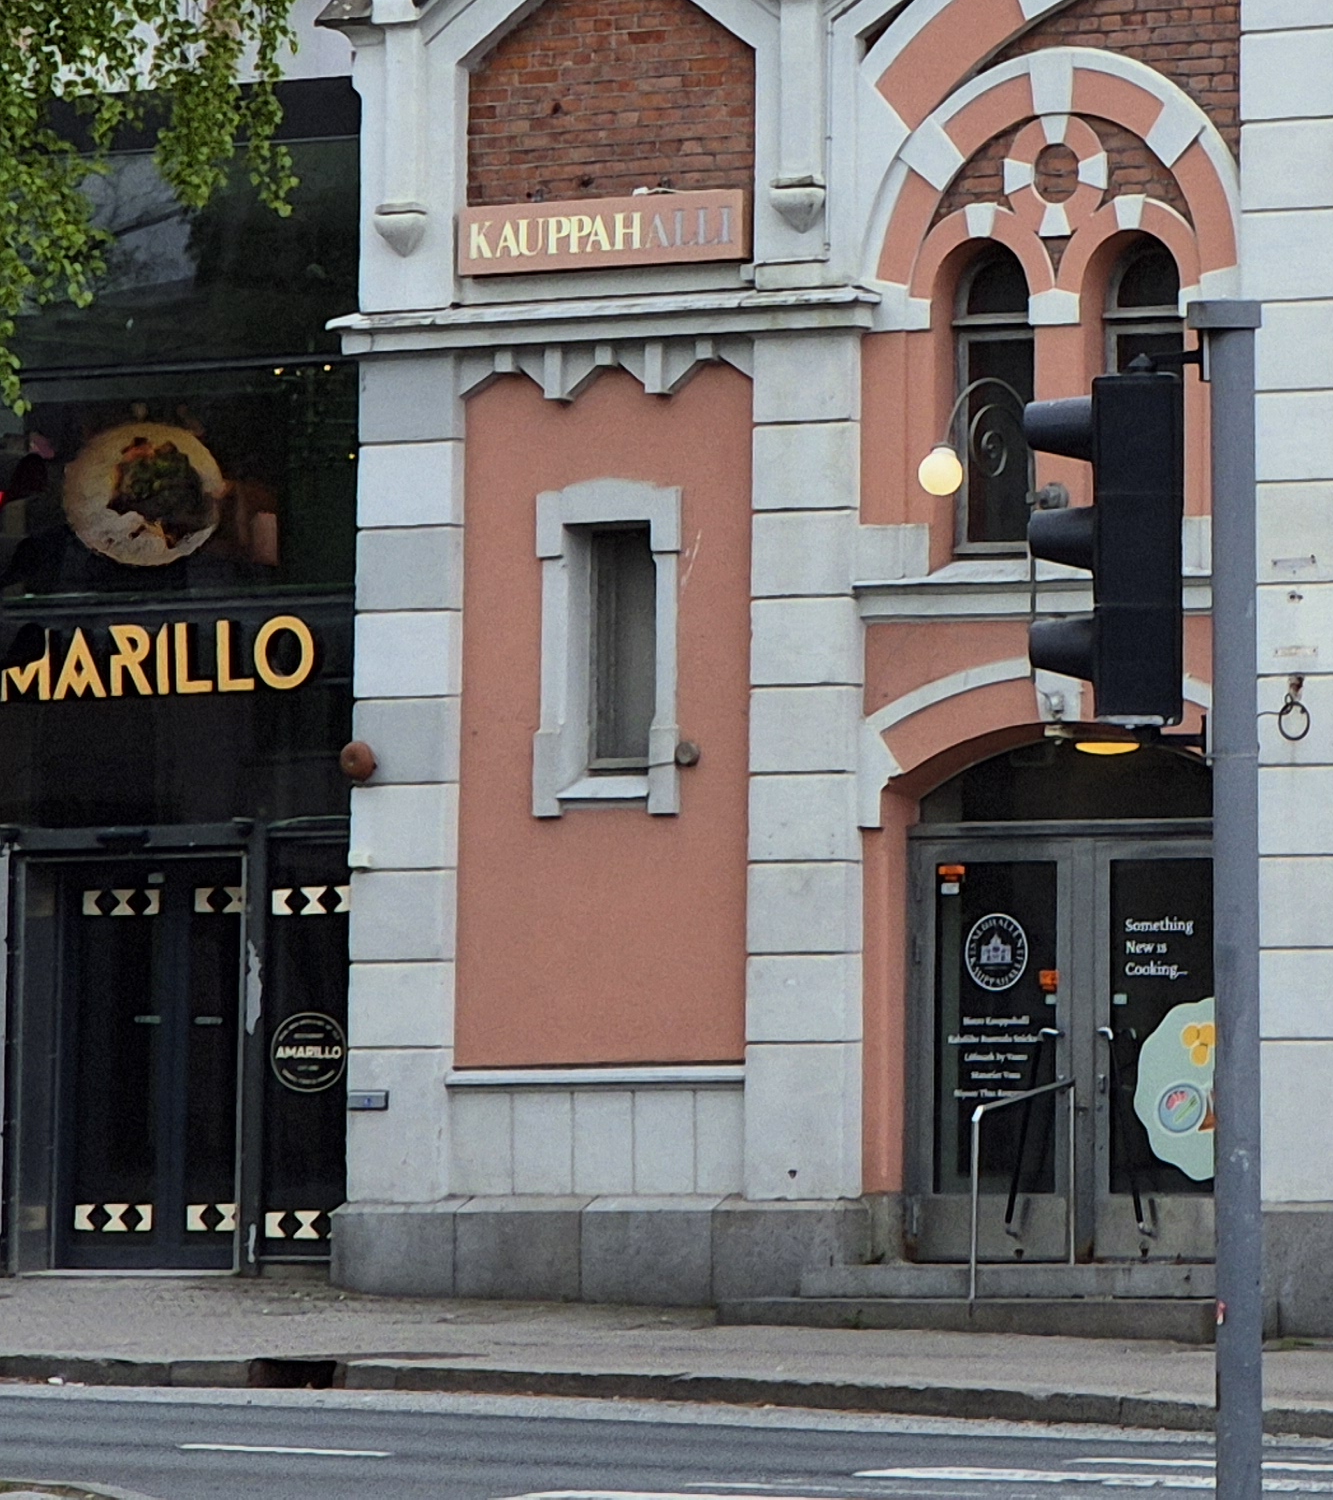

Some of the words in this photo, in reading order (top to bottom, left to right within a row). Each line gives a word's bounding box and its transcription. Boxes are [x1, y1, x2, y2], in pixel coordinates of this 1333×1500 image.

[468, 206, 735, 261] KAUPPAHALLI
[1124, 915, 1195, 936] Something
[1125, 940, 1155, 955] New
[1156, 941, 1168, 954] is
[275, 1045, 342, 1060] AMARILLO
